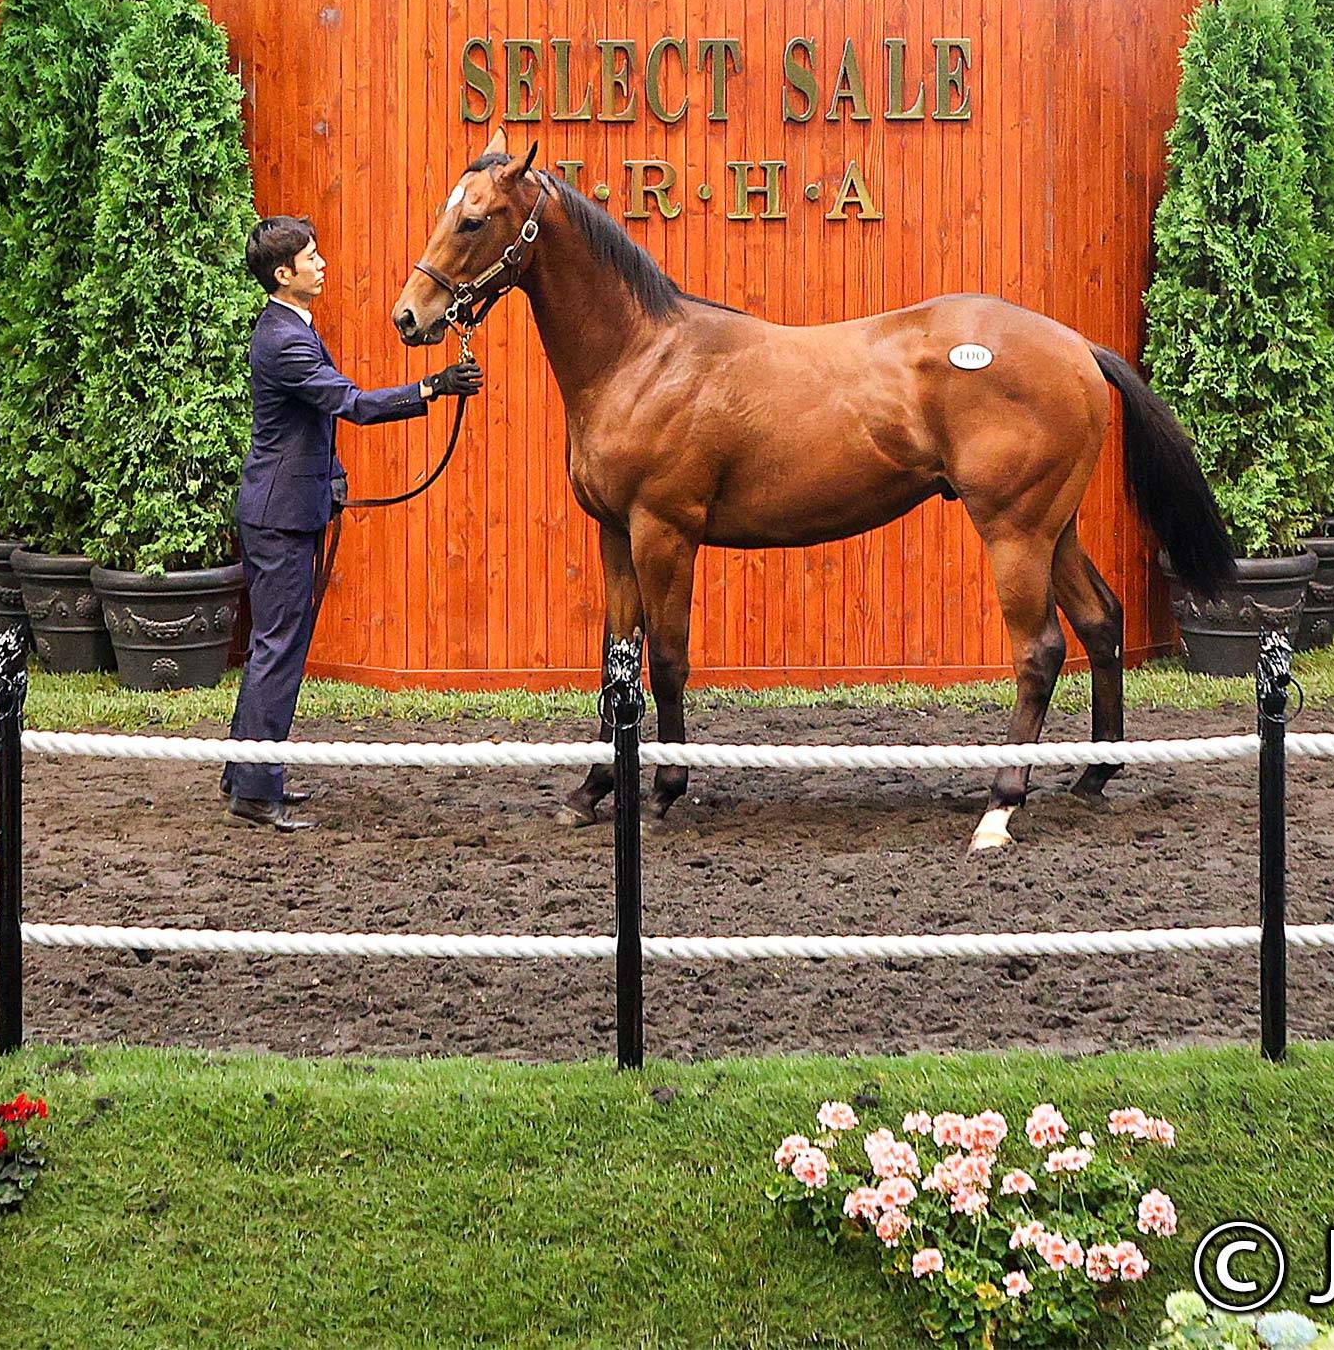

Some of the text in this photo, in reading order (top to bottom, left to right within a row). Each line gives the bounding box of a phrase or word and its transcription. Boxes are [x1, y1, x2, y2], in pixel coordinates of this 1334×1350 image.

[460, 36, 972, 123] SELECT SALE
[959, 350, 985, 360] 100
